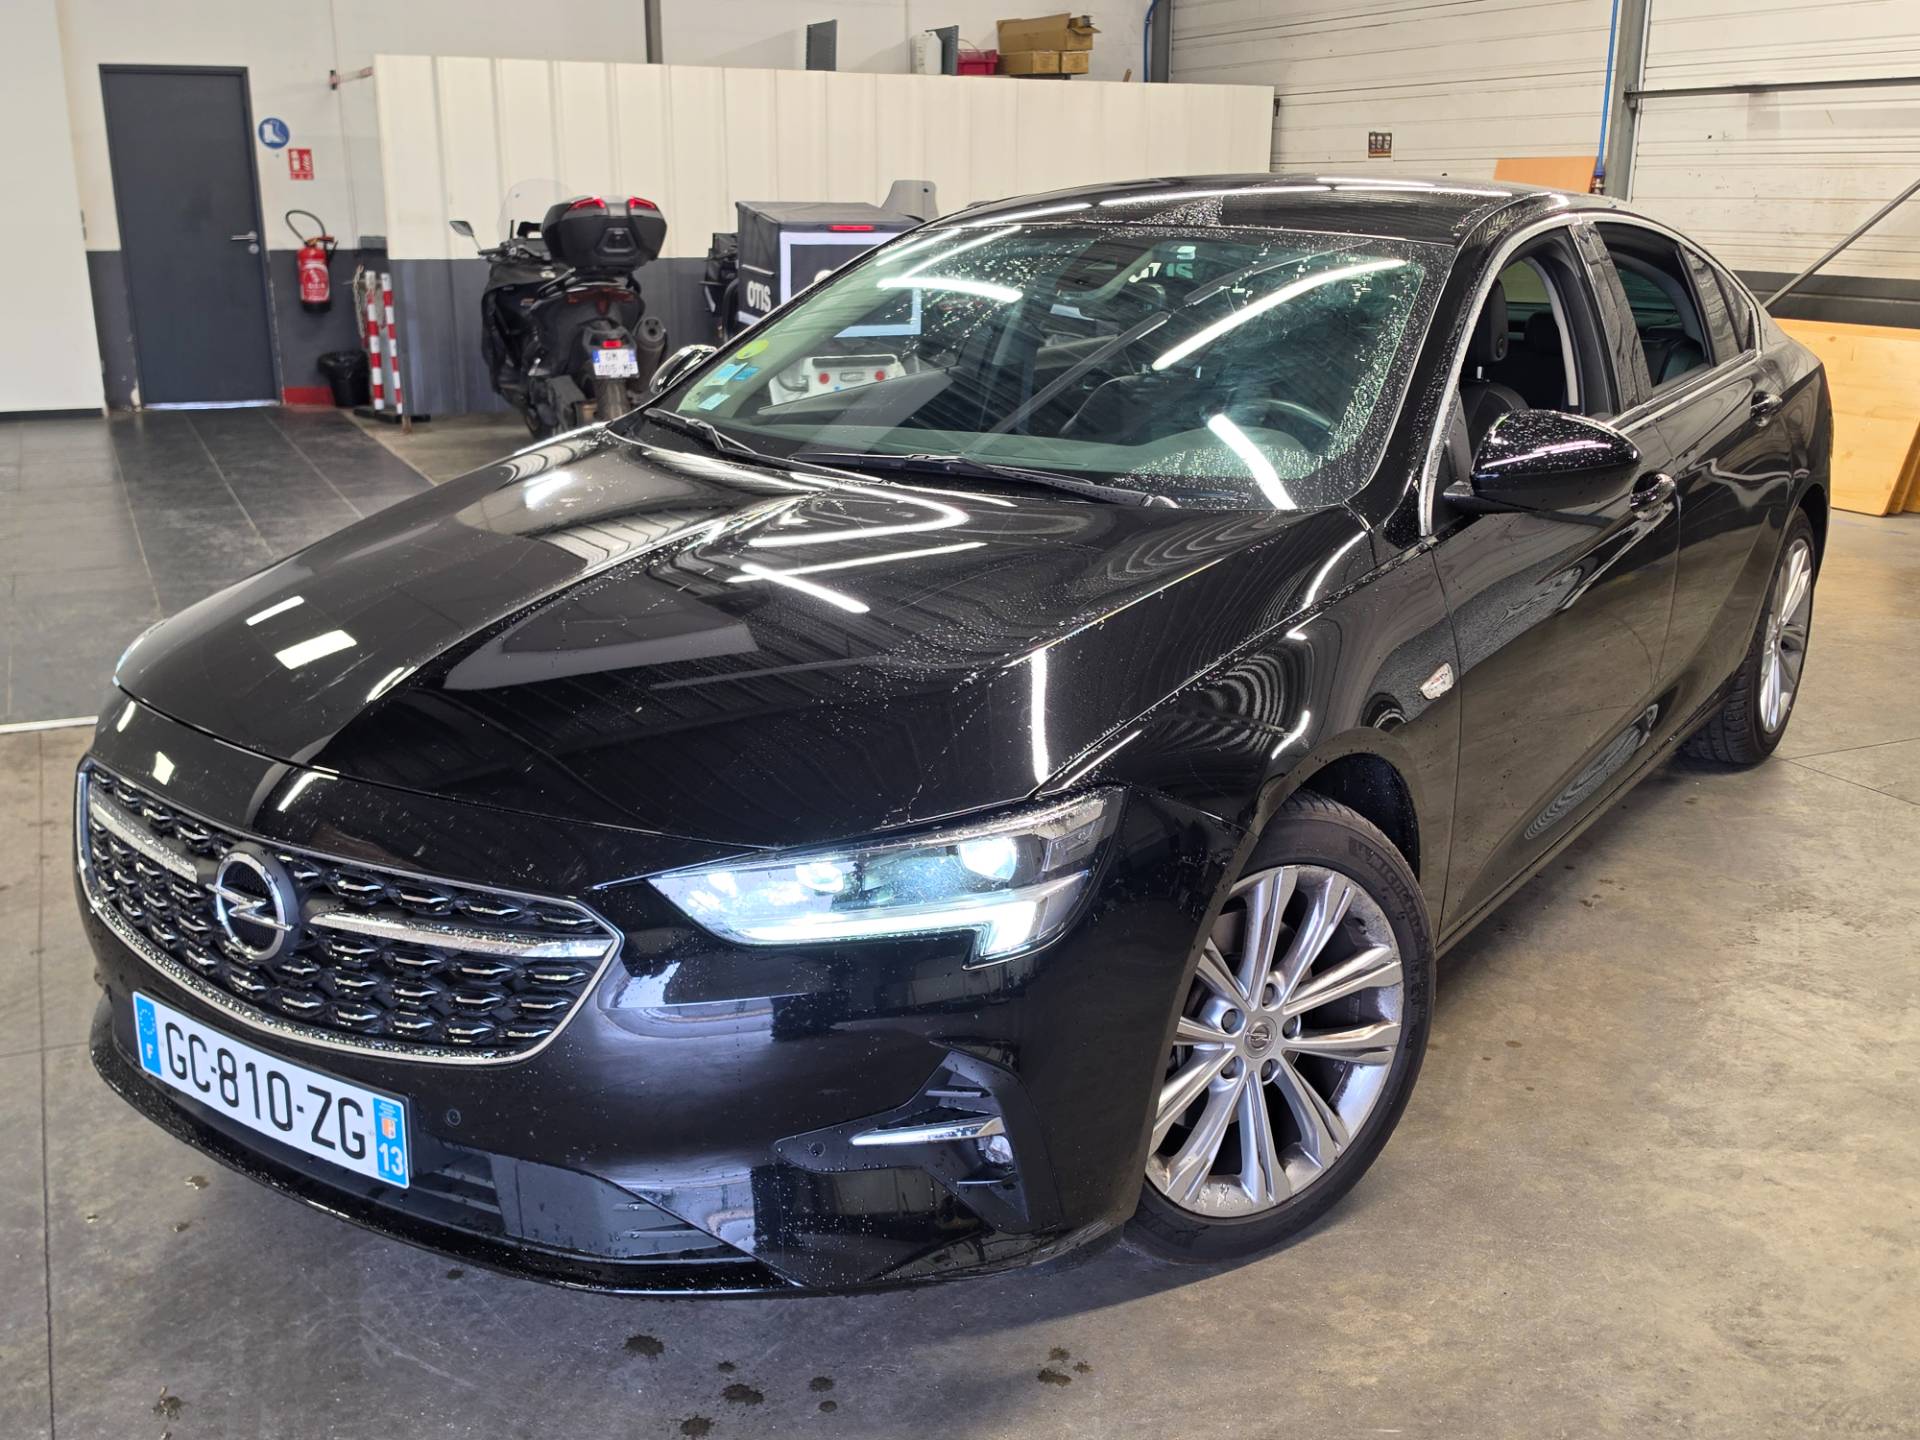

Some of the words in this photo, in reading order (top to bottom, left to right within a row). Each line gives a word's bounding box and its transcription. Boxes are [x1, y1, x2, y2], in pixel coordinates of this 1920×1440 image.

[747, 280, 771, 313] OTIS
[165, 1022, 366, 1160] GC-810-ZG
[379, 1142, 404, 1176] 13
